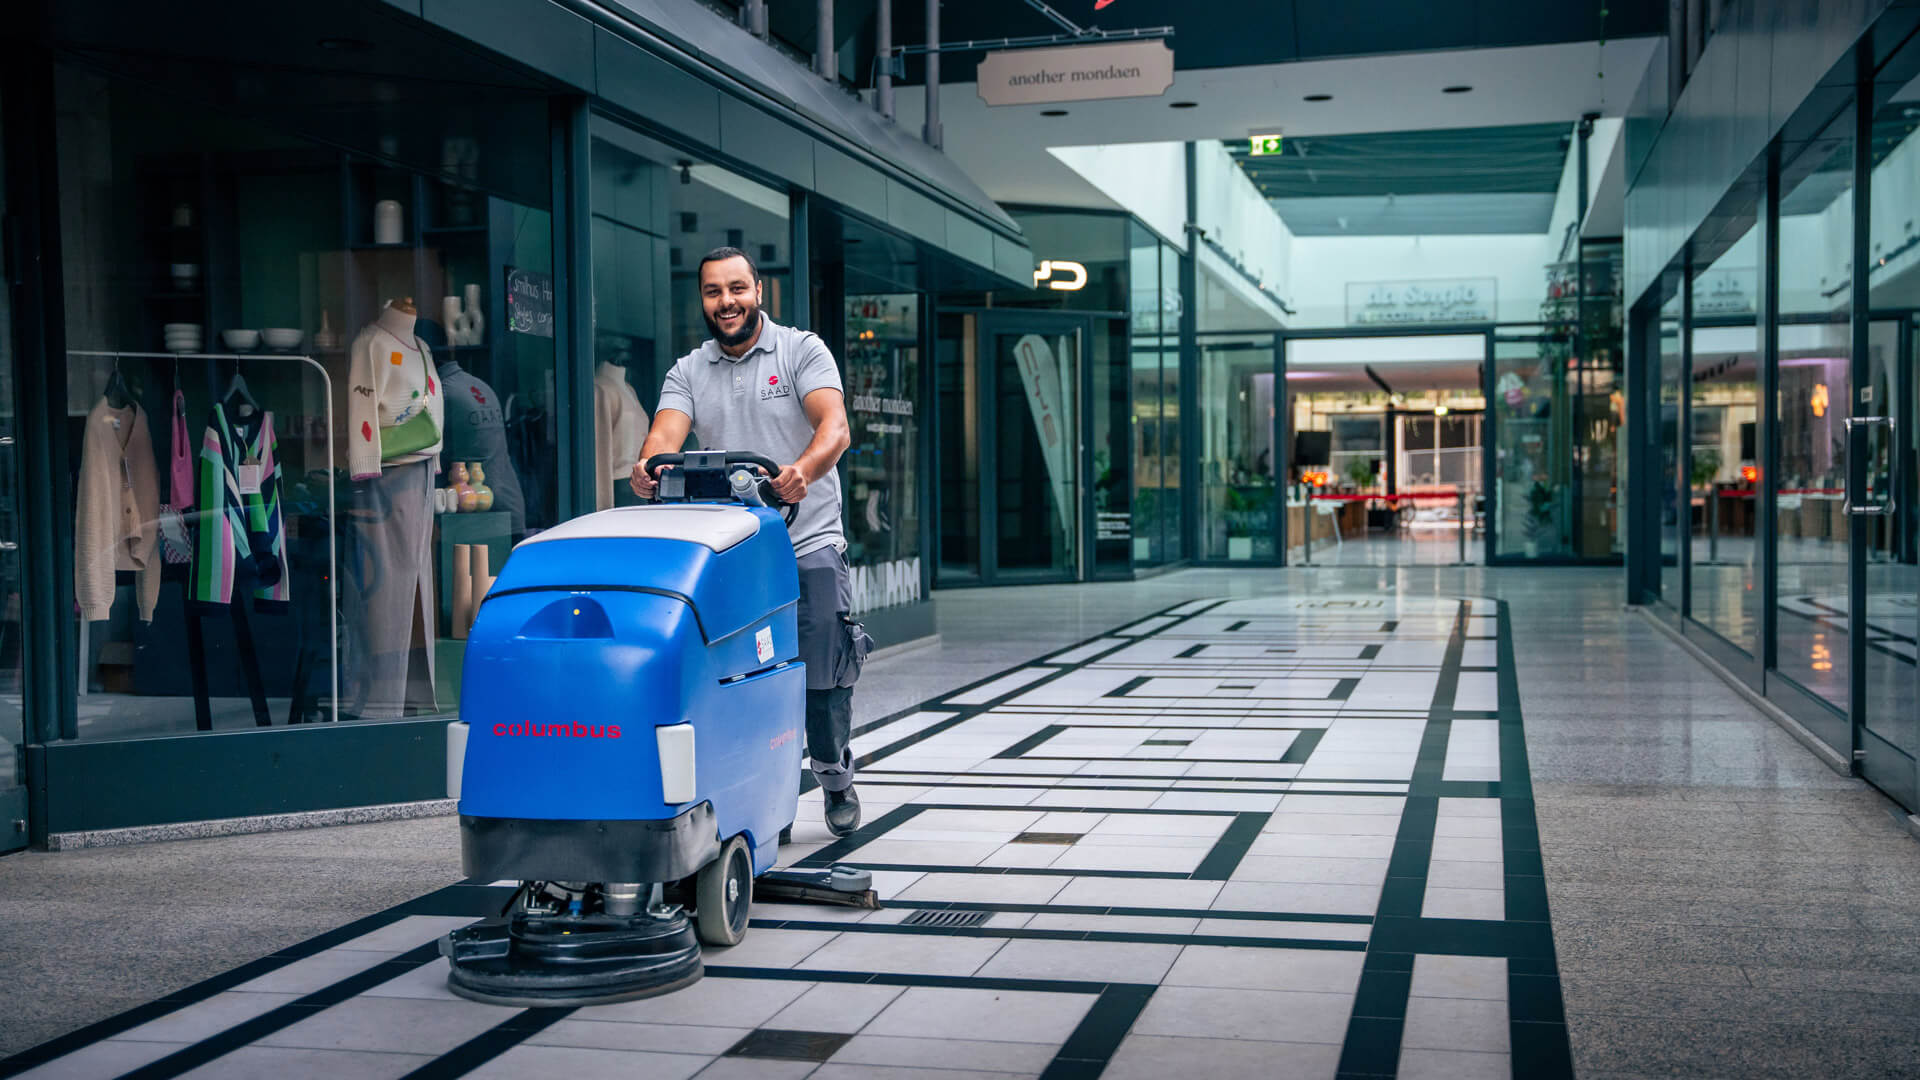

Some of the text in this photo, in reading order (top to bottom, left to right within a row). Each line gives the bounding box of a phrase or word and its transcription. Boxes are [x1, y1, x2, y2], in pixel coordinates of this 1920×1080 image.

[1008, 65, 1140, 86] another mondaen
[760, 385, 790, 398] SAAD
[492, 719, 622, 739] columbus
